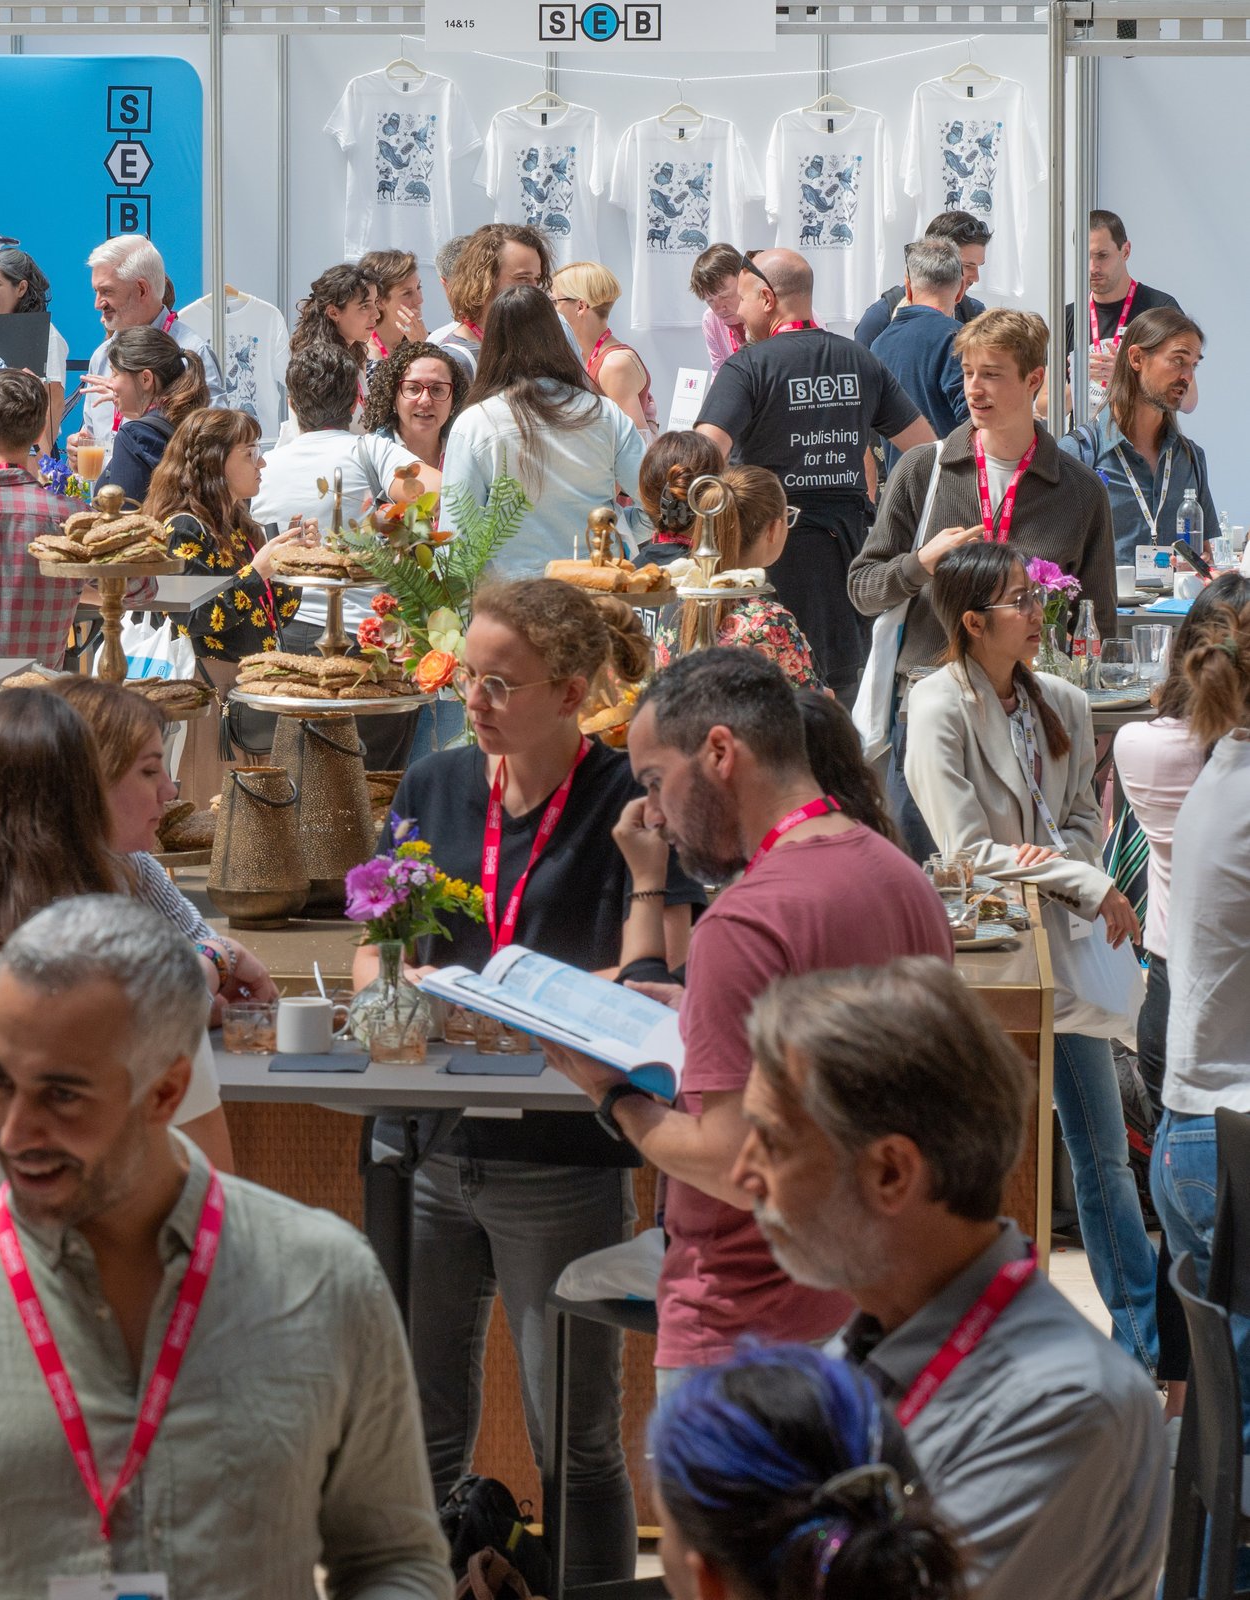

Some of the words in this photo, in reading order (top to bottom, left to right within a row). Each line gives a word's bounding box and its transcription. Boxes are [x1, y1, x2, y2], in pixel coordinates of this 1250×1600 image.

[444, 19, 475, 28] 14&15
[546, 8, 654, 37] SEB
[794, 376, 857, 401] SEB
[790, 428, 859, 447] Publishing
[803, 452, 822, 466] for
[825, 450, 846, 464] the
[784, 469, 860, 487] Community
